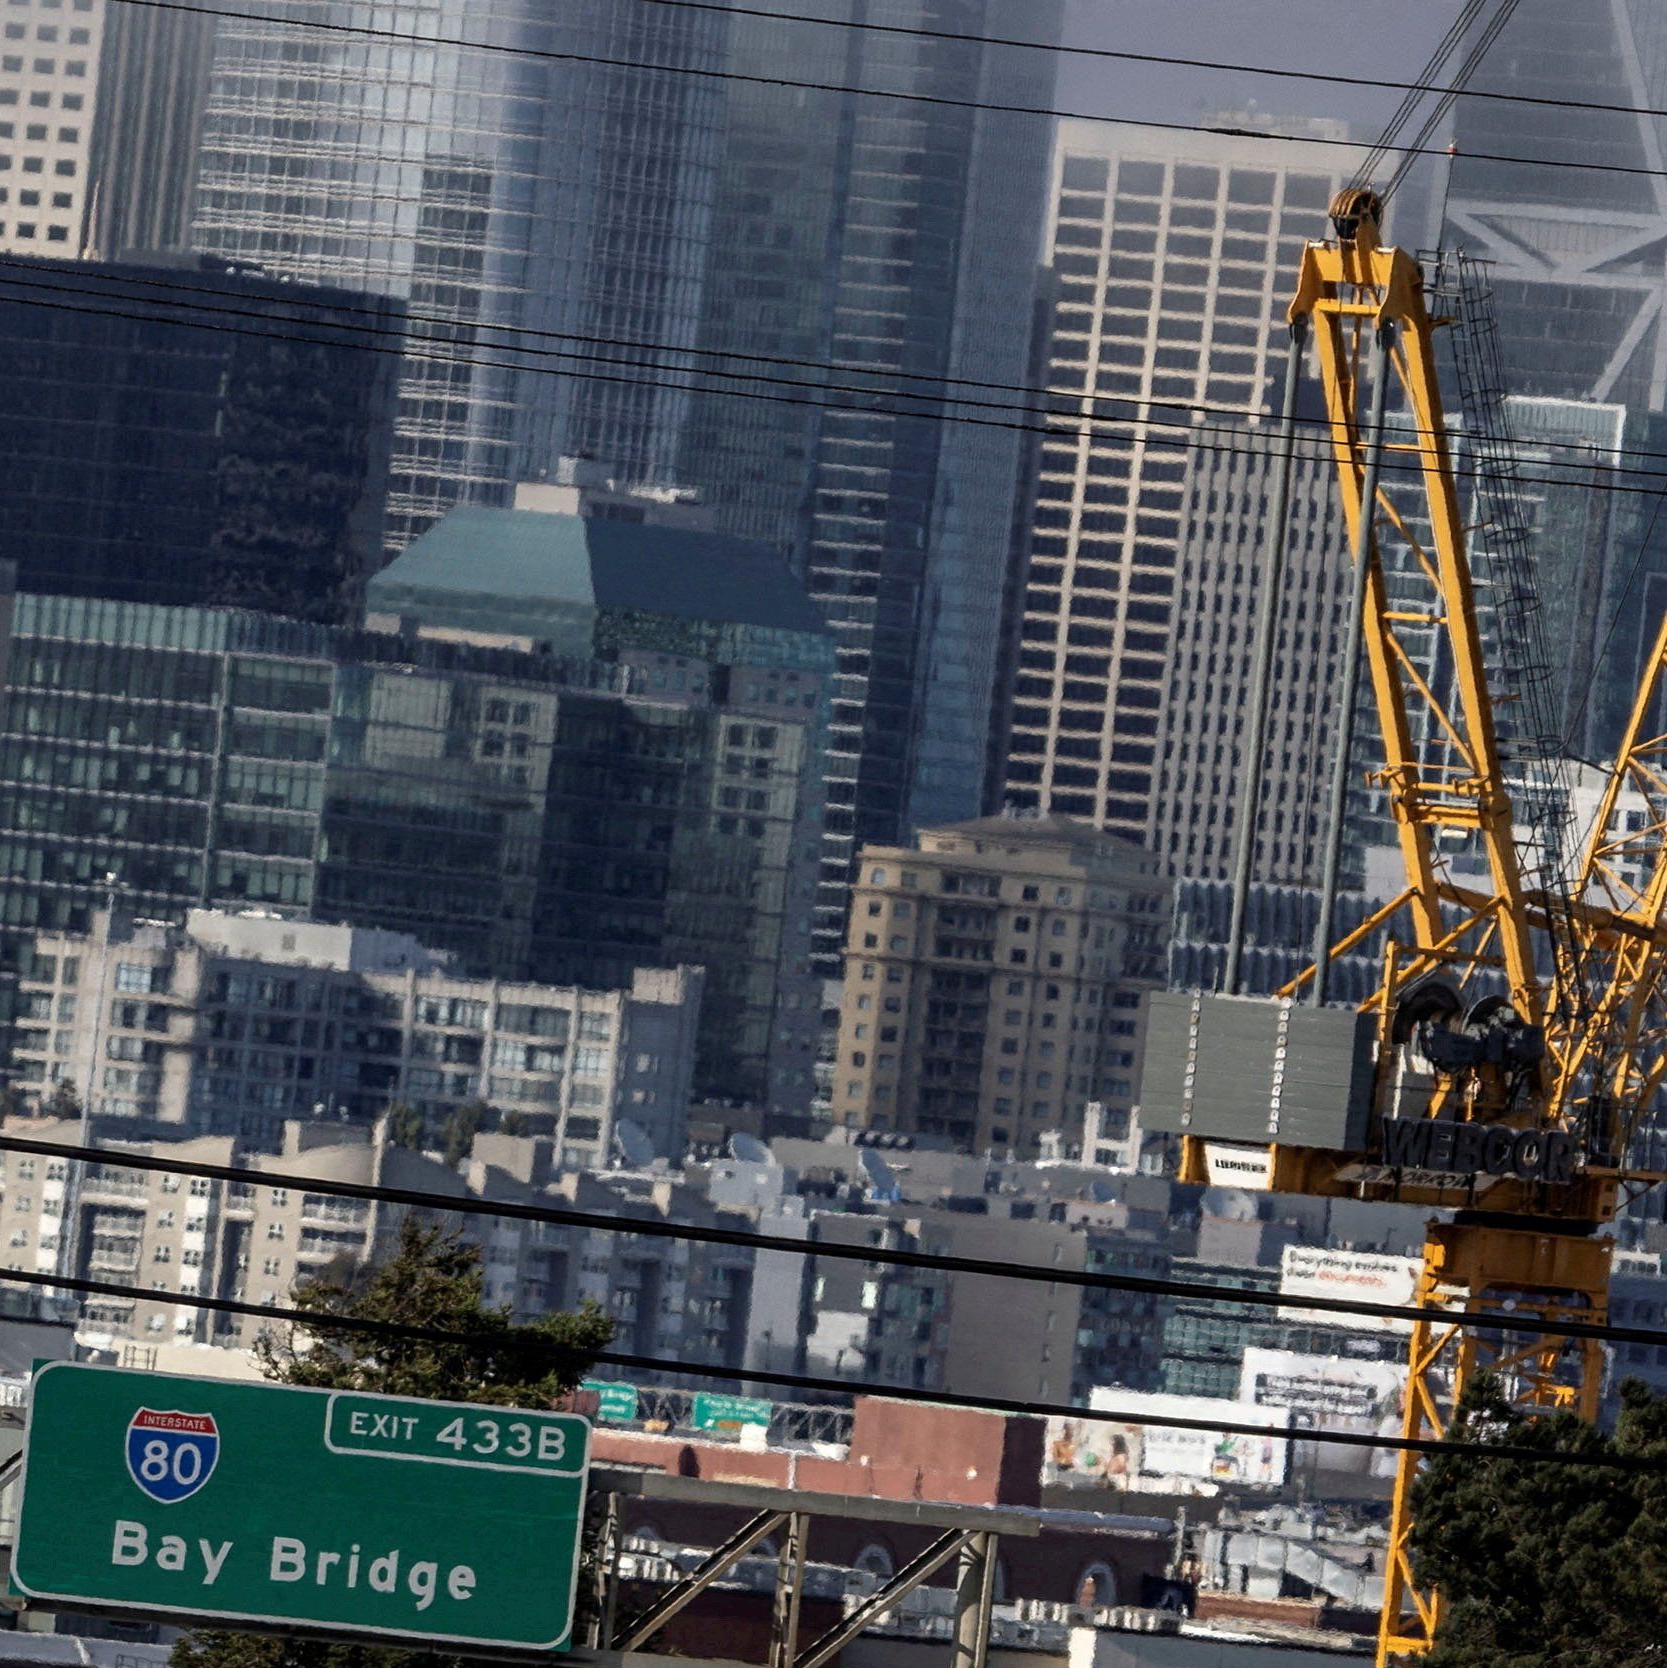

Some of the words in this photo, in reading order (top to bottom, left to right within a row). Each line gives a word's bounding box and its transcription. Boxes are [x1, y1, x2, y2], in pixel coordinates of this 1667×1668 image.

[1383, 1116, 1574, 1184] WEBCOR
[142, 1414, 207, 1431] INTERSTATE
[349, 1411, 419, 1442] EXIT
[435, 1417, 567, 1463] 433B
[140, 1440, 202, 1486] 80
[111, 1519, 234, 1585] Bay
[270, 1535, 477, 1611] Bridge
